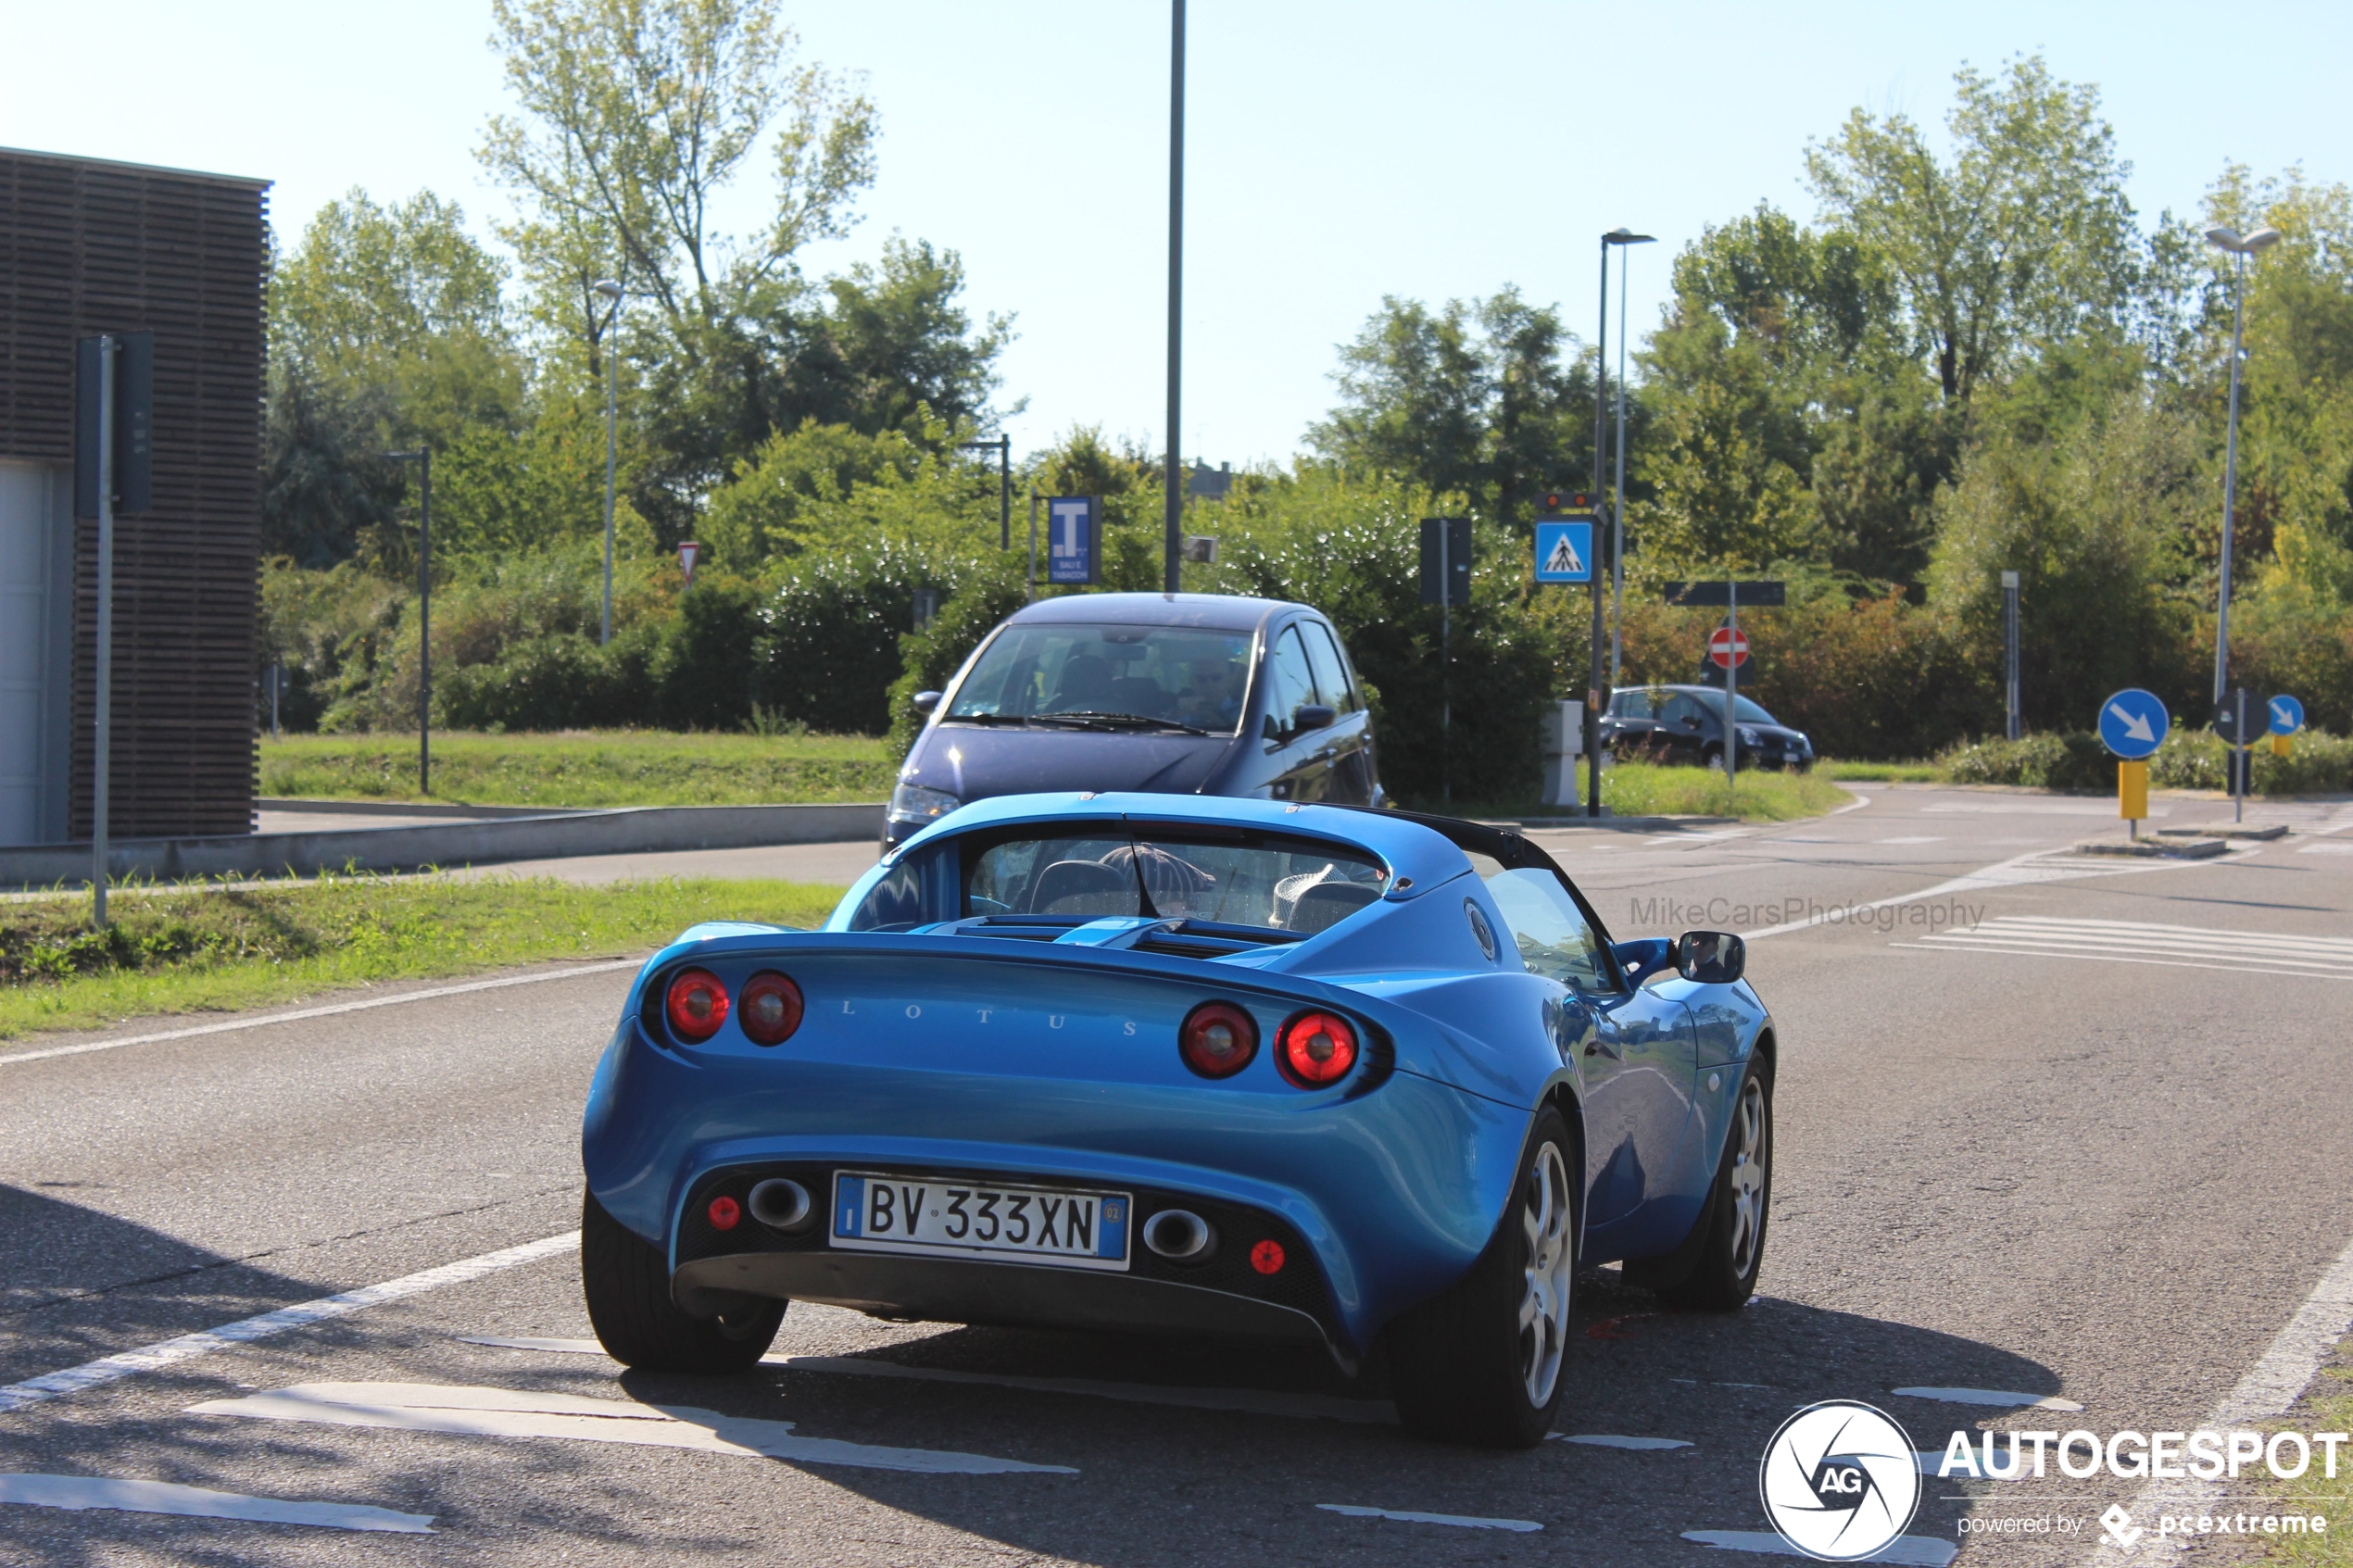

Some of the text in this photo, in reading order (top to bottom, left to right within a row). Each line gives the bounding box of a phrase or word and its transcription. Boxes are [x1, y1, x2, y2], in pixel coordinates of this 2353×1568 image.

[1053, 503, 1088, 557] T
[842, 1000, 1136, 1035] LOTUS
[869, 1184, 925, 1236] BV
[945, 1189, 1093, 1249] 333XN
[1105, 1206, 1120, 1220] 02
